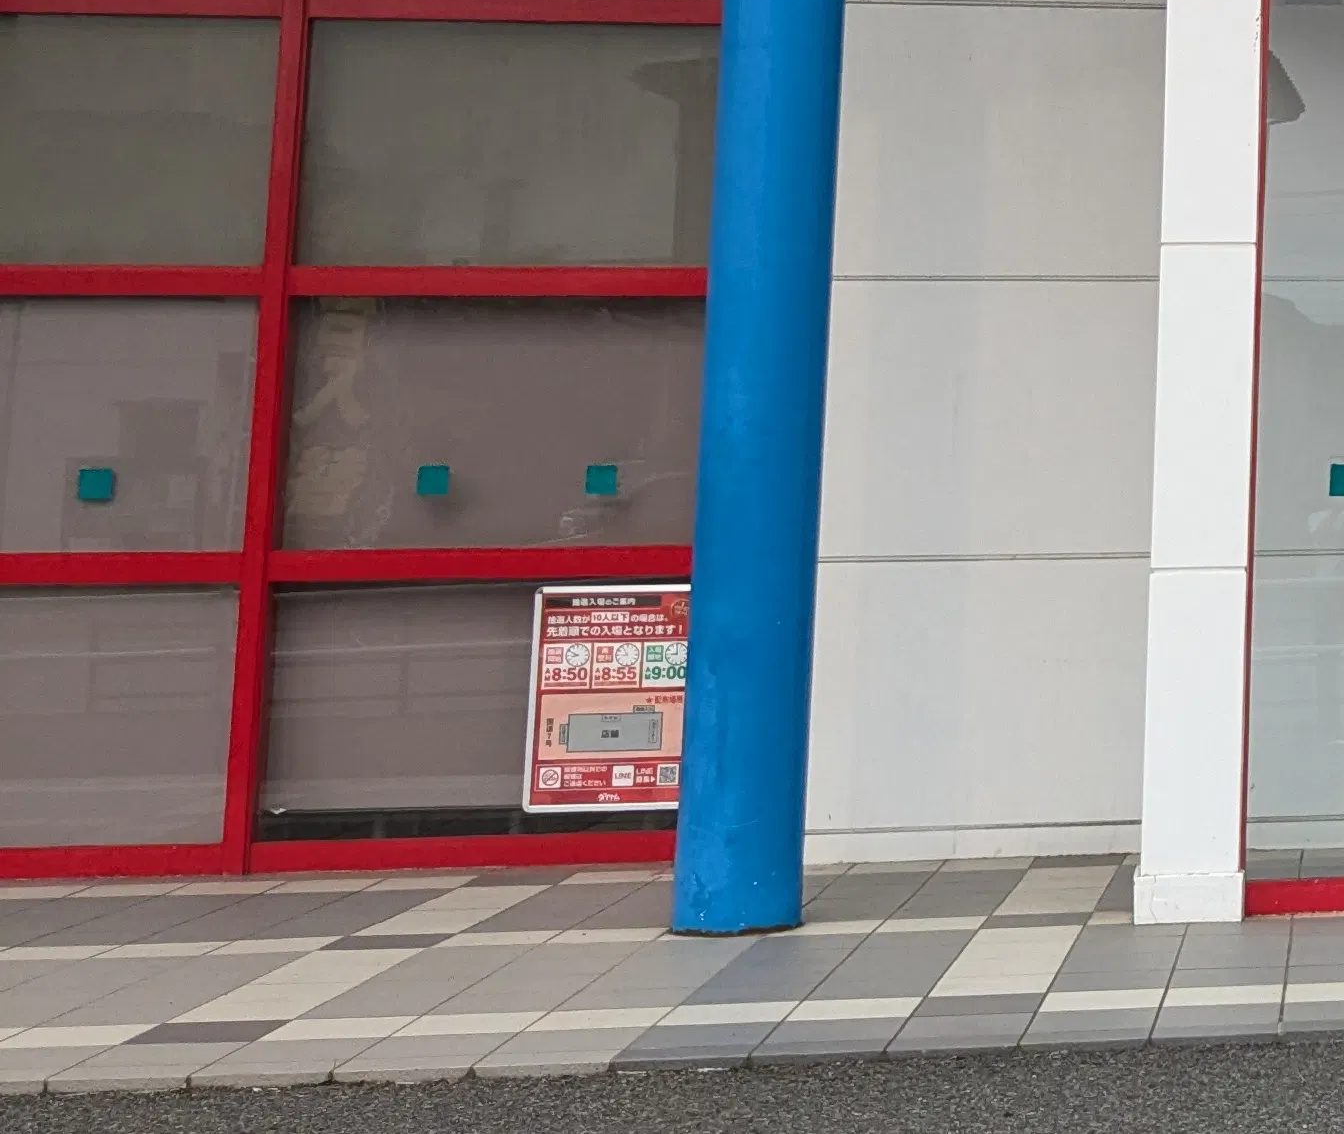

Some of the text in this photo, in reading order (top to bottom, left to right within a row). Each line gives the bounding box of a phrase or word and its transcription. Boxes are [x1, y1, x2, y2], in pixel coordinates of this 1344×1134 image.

[551, 667, 588, 681] 8:50
[601, 667, 637, 681] 8:55
[651, 666, 685, 679] 9:00
